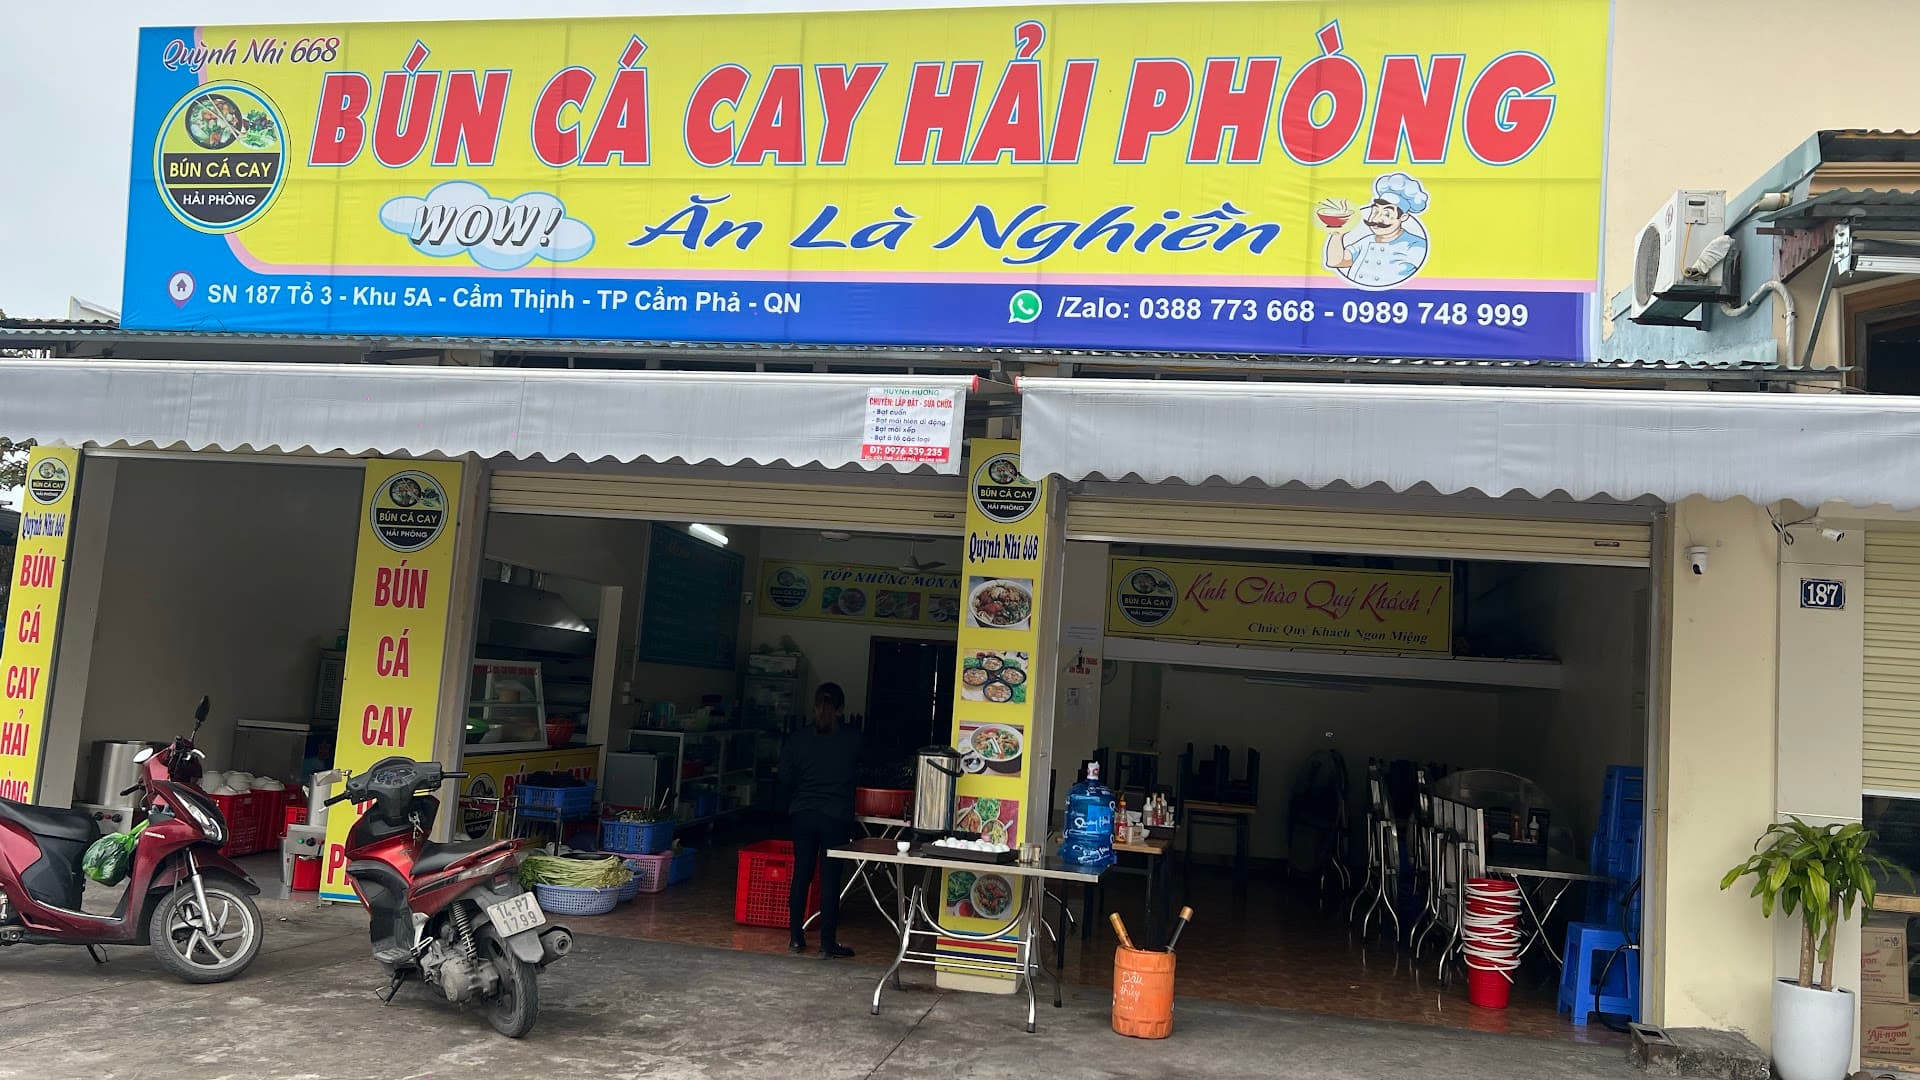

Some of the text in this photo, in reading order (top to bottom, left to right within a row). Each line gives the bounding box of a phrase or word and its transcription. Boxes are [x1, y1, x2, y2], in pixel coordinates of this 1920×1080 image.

[163, 37, 340, 73] Quỳnh Nhi 668
[308, 19, 1557, 168] BÚN CÁ CAY HẢI PHÒNG
[170, 157, 272, 177] BÚN CÁ CAY
[183, 191, 256, 205] HẢI PHÒNG
[410, 204, 564, 248] WOW!
[625, 193, 1282, 266] Ăn Là Nghiền
[207, 284, 237, 304] SN
[244, 285, 281, 305] 187
[287, 281, 314, 305] Tổ
[320, 286, 333, 305] 3
[353, 286, 396, 306] Khu
[403, 287, 433, 307] 5A
[453, 284, 502, 308] Cẩm
[510, 288, 575, 314] Thịnh
[597, 290, 628, 310] TP
[634, 286, 687, 312] Cẩm
[695, 291, 741, 313] Phả
[763, 292, 801, 313] QN
[1056, 296, 1129, 319] /Zalo:
[1139, 297, 1202, 320] 0388
[1210, 299, 1258, 321] 773
[1266, 299, 1315, 322] 668
[1342, 301, 1409, 324] 0989
[1417, 302, 1468, 325] 748
[1477, 303, 1528, 327] 999
[870, 446, 943, 456] ĐT: 0976.539.235
[981, 489, 997, 497] BÚN
[999, 488, 1012, 498] CÁ
[380, 511, 437, 524] BÚN CÁ CAY
[969, 530, 1038, 563] Quỳnh Nhi 668
[19, 548, 57, 588] BÚN
[374, 559, 428, 609] BÚN
[1184, 571, 1228, 612] Kính
[1235, 576, 1297, 605] Chào
[1305, 580, 1358, 620] Quý
[1360, 582, 1422, 622] Khách
[1807, 583, 1839, 606] 187
[18, 603, 41, 643] CÁ
[377, 628, 409, 677] CÁ
[6, 665, 40, 700] CAY
[0, 709, 30, 756] HẢI
[361, 704, 413, 747] CAY
[504, 911, 538, 932] 1799
